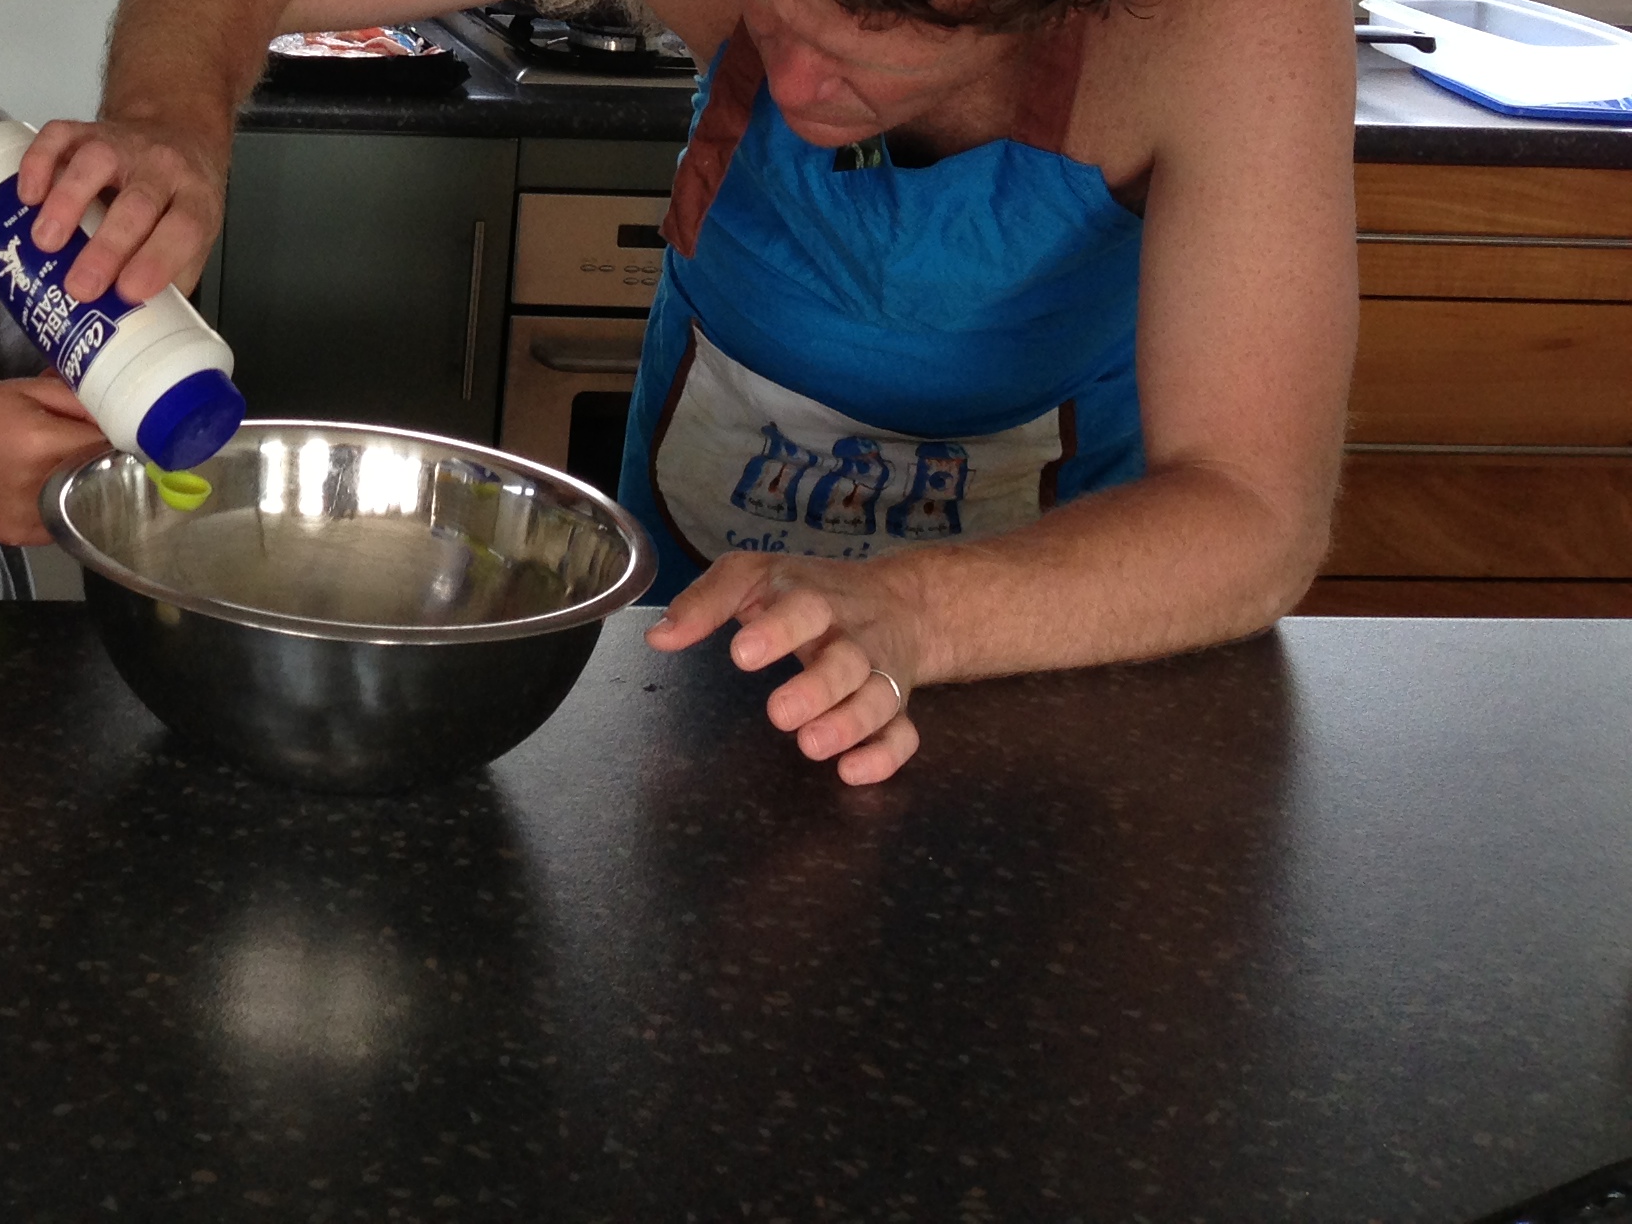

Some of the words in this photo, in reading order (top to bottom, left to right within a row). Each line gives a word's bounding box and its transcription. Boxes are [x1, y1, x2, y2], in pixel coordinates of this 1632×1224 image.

[29, 277, 43, 296] how
[30, 284, 62, 333] SALT
[39, 293, 80, 352] TABLE
[65, 321, 104, 384] Cerebos
